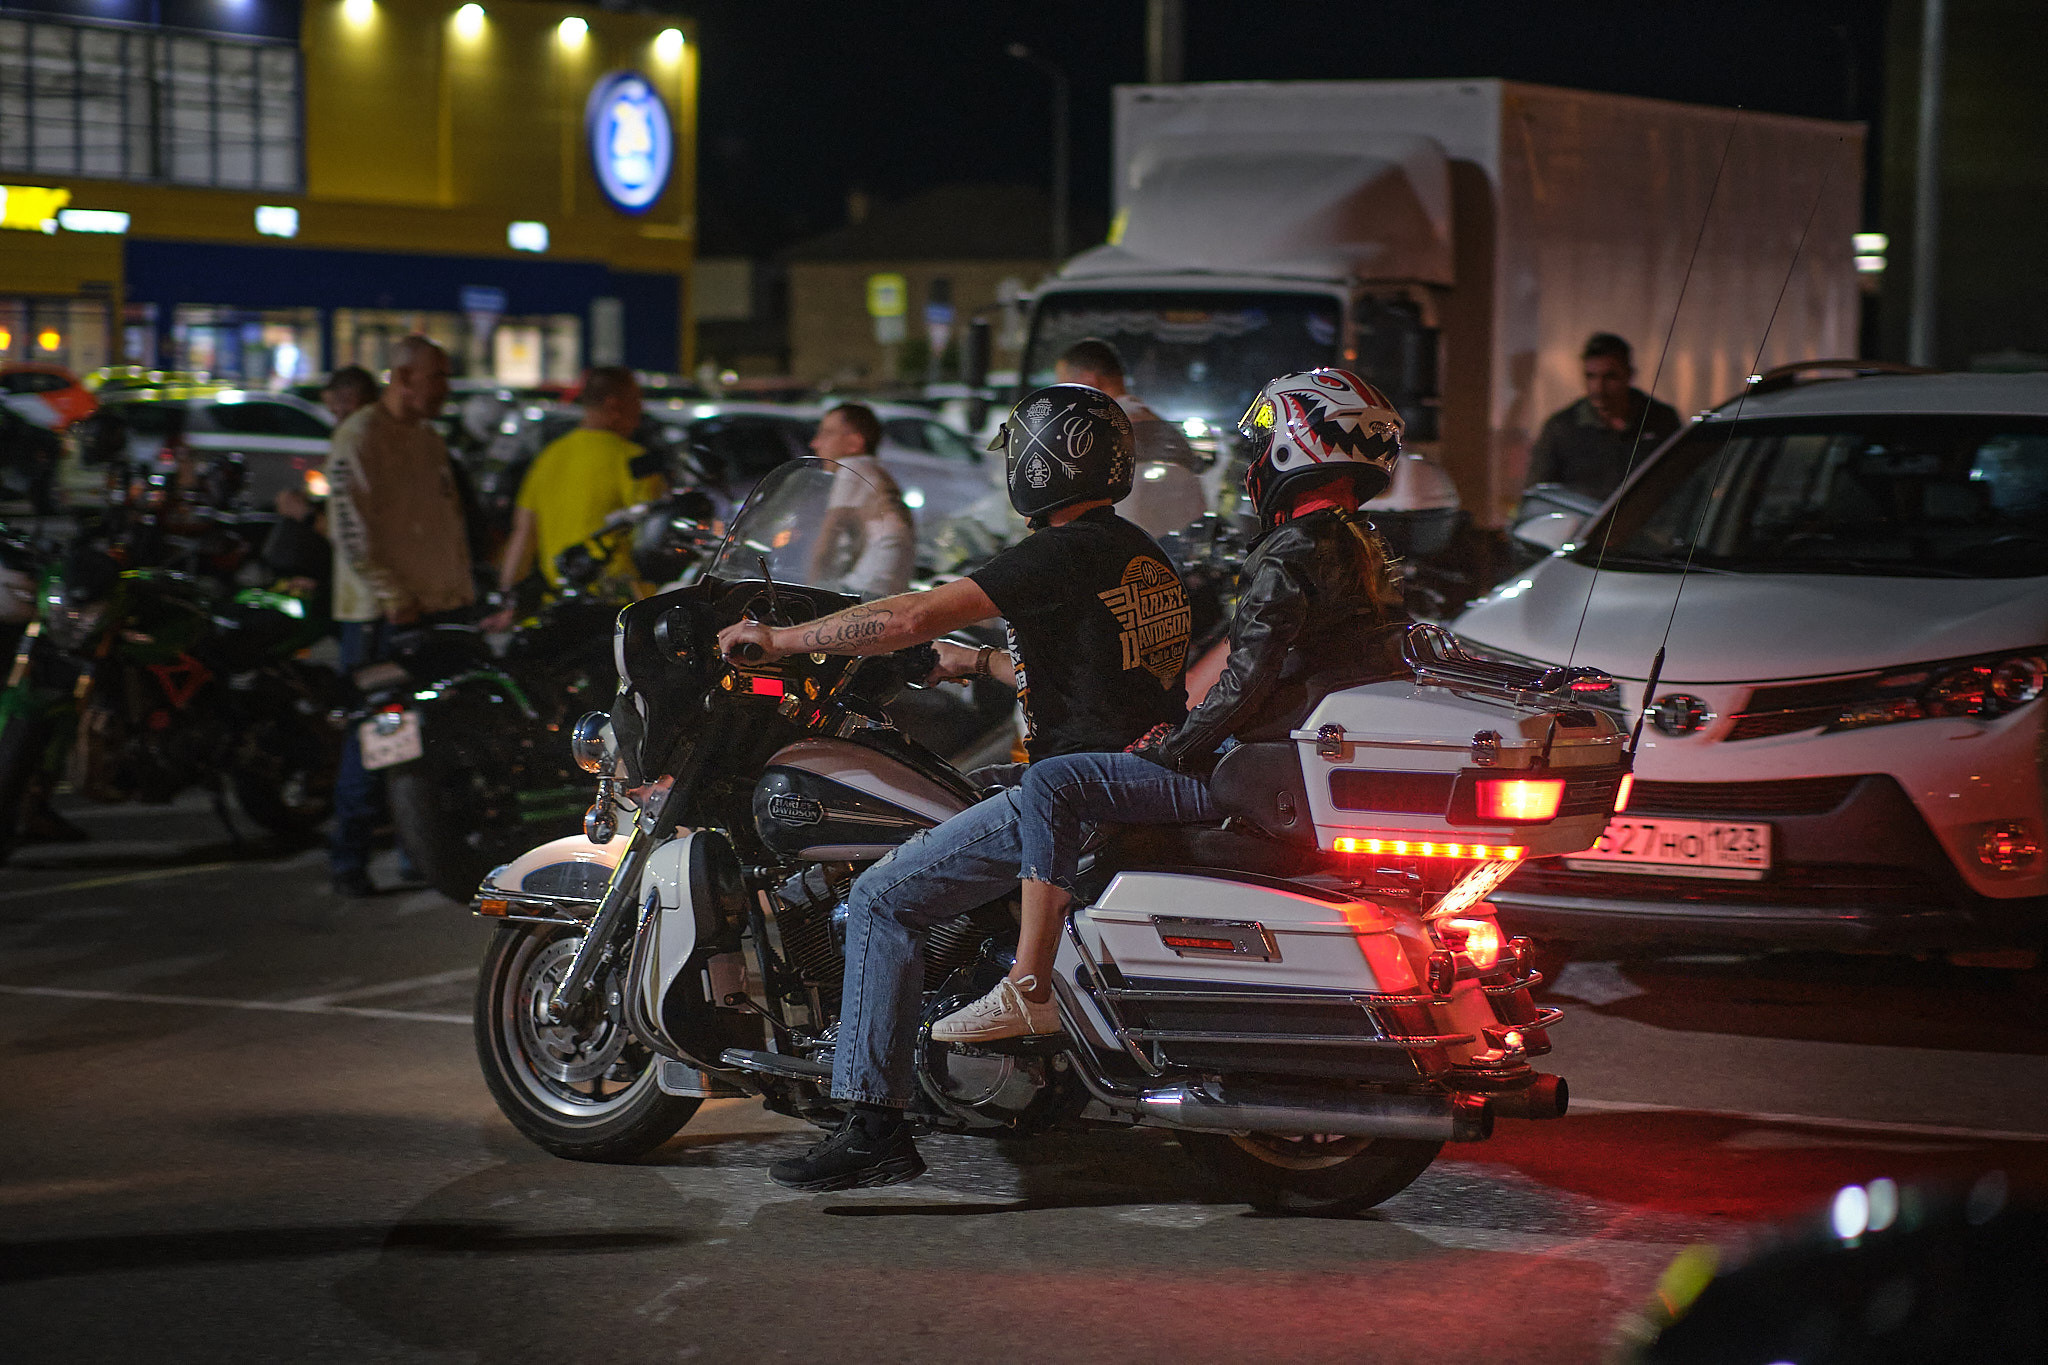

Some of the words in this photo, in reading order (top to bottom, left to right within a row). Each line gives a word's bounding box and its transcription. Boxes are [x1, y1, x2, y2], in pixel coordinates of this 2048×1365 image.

[1119, 613, 1191, 670] DAVIDSON
[772, 806, 818, 819] DAVIDSON
[1709, 827, 1761, 852] 123
